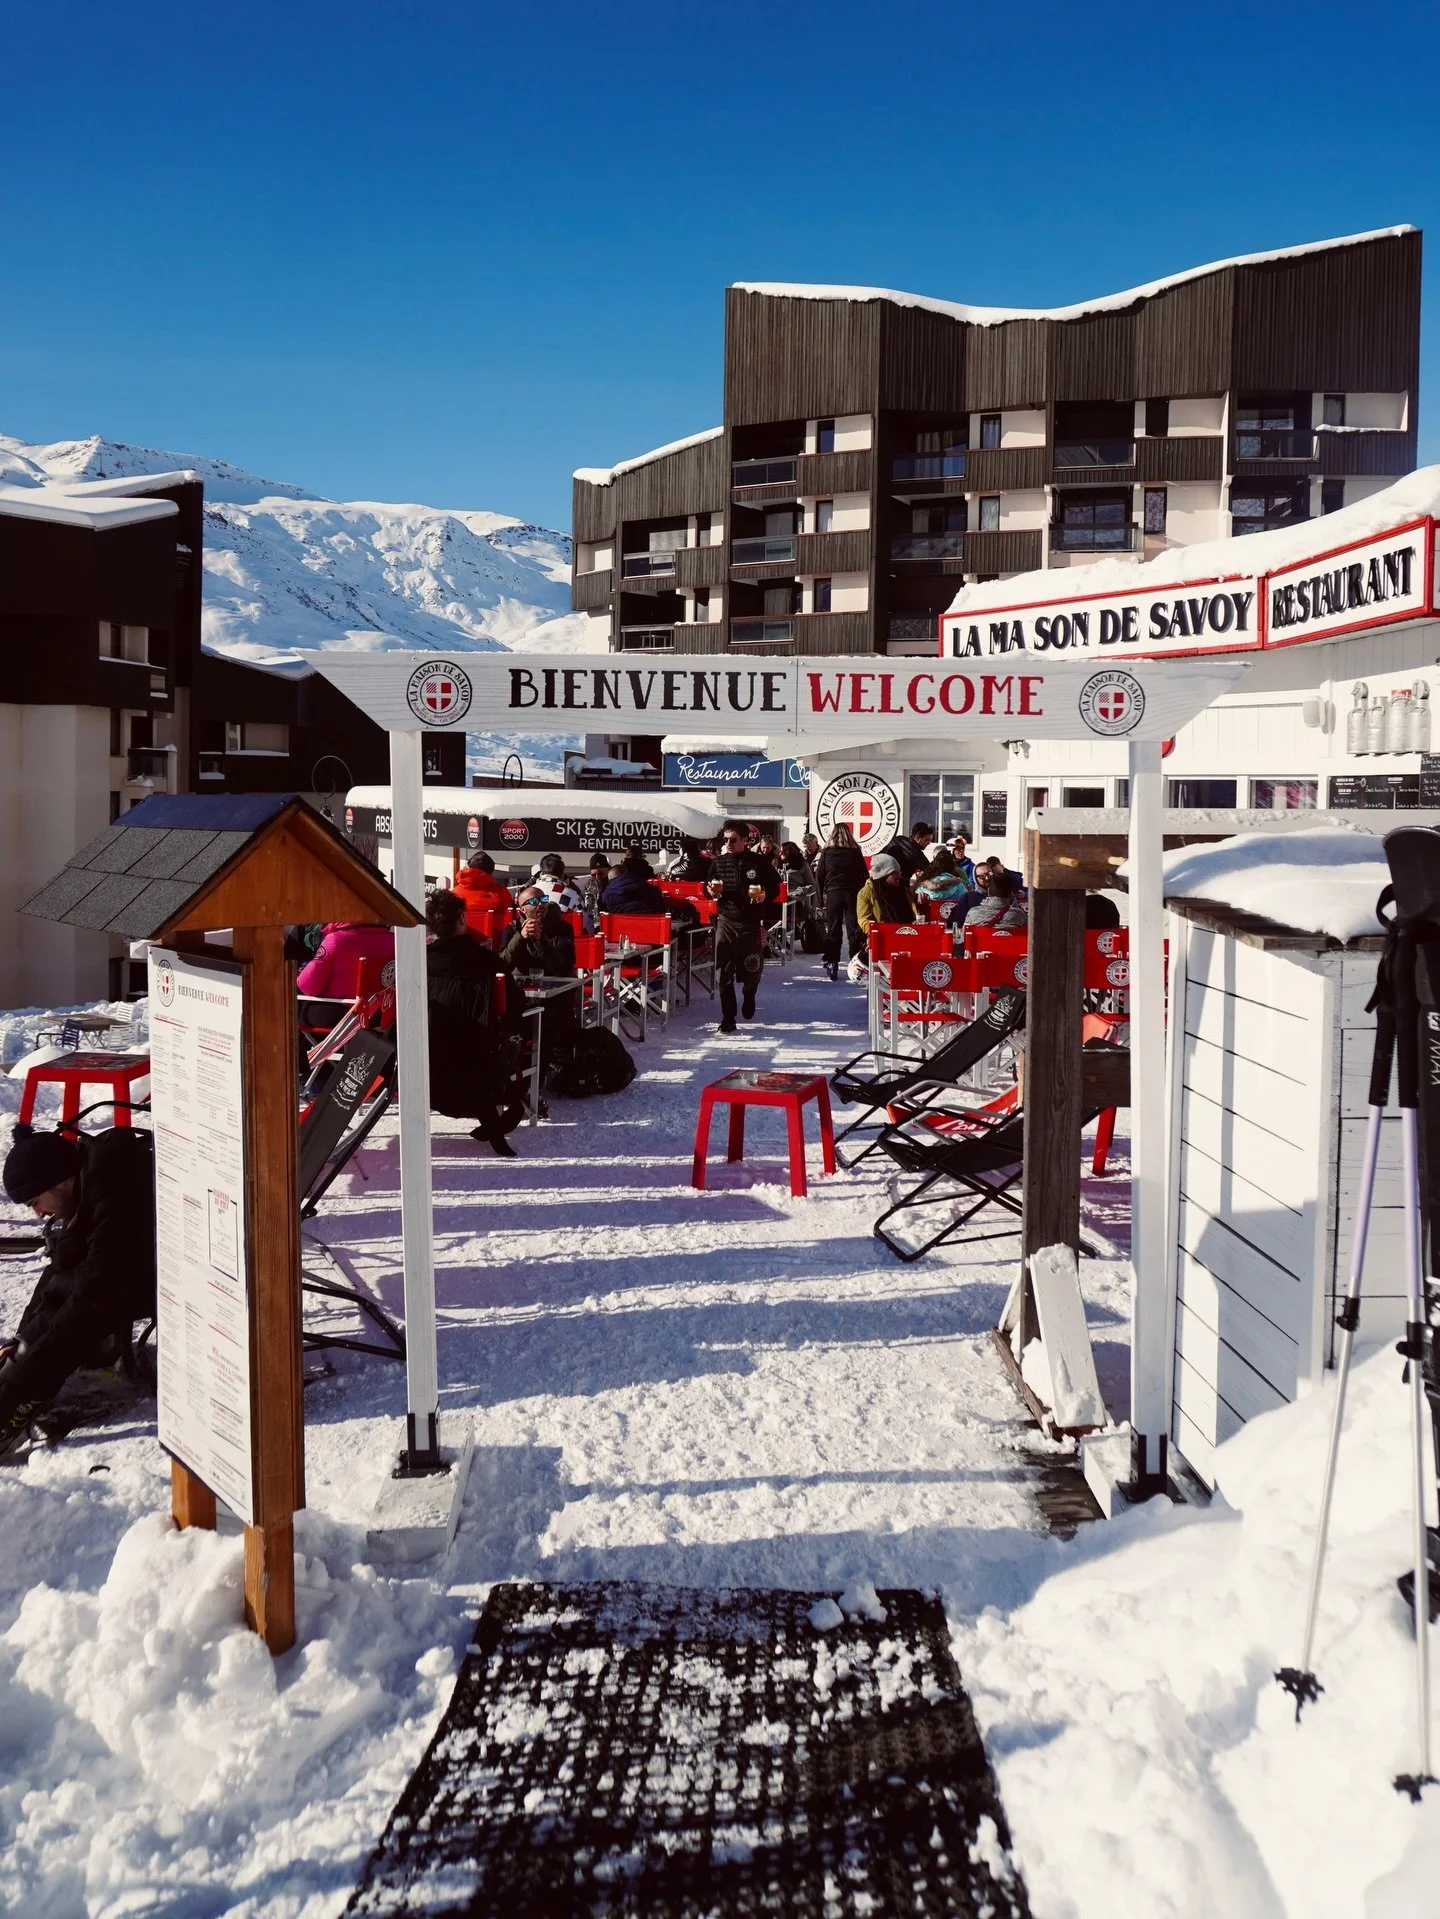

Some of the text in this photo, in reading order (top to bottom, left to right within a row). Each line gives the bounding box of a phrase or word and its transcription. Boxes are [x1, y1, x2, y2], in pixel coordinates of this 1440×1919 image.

[952, 625, 983, 658] LA
[1099, 606, 1141, 645] DE
[1149, 591, 1255, 640] SAVOY
[1272, 546, 1417, 630] RESTAURANT
[410, 663, 469, 704] LA MAISON DE SAVOY
[508, 668, 1044, 716] BIENVENUE WELCOME
[1084, 673, 1115, 698] MAISON
[1127, 683, 1142, 713] SAVOY
[1082, 700, 1090, 712] LA
[677, 755, 770, 785] Restaurant
[820, 776, 897, 830] LA MAISON DE SAVOY
[556, 821, 581, 836] SKI
[585, 822, 596, 836] &
[579, 838, 628, 850] RENTAL
[641, 839, 681, 851] SALES
